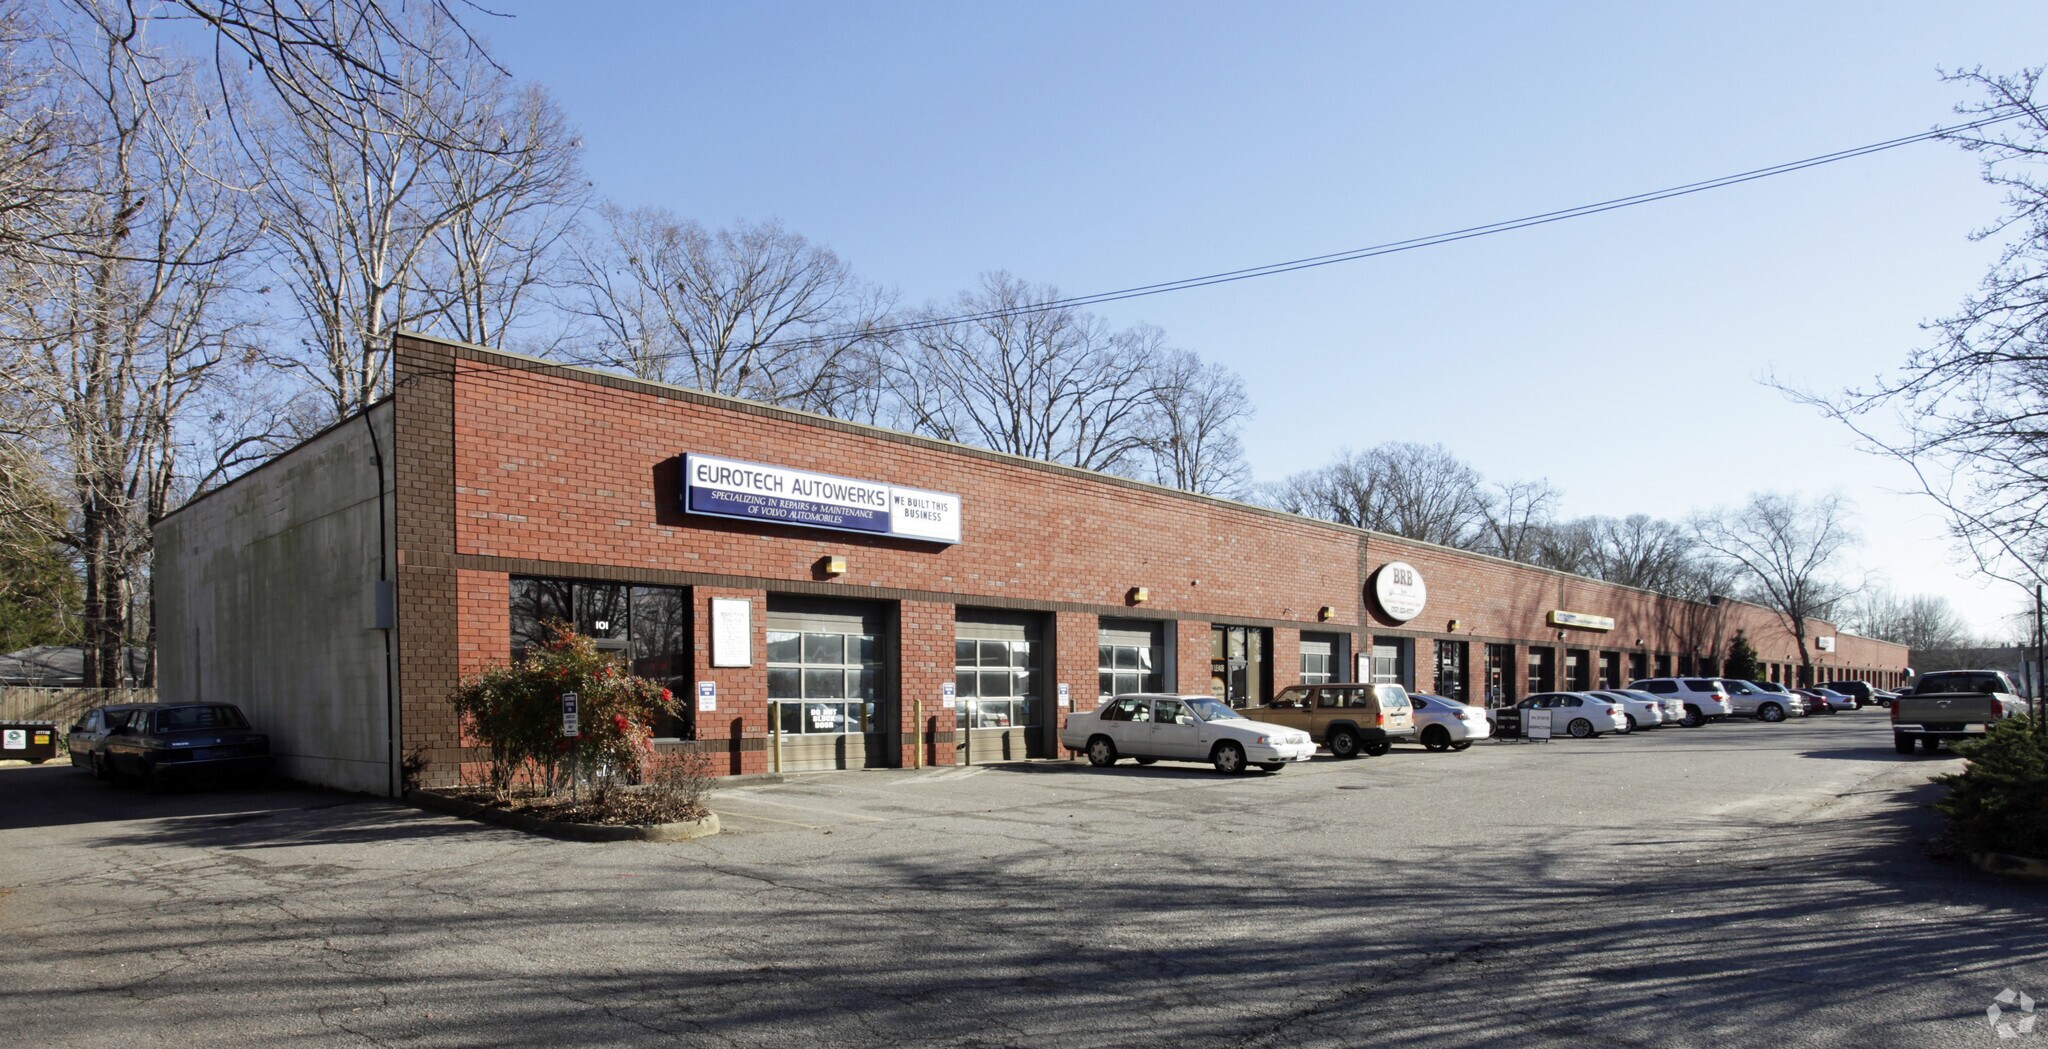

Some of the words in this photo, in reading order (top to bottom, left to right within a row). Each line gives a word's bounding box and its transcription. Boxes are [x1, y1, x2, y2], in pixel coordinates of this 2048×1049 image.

[697, 464, 783, 492] EUROTECH
[792, 478, 885, 506] AUTOWERKS
[711, 490, 766, 505] SPECIALIZING
[768, 498, 778, 506] IN
[780, 499, 809, 511] REPAIRS
[820, 505, 873, 518] MAINTENANCE
[894, 496, 904, 505] WE
[907, 497, 929, 508] BUILT
[932, 501, 948, 511] THIS
[748, 505, 759, 514] OF
[761, 507, 786, 517] VOLVO
[789, 510, 842, 523] AUTOMOBILES
[904, 508, 941, 521] BUSINESS
[1393, 567, 1413, 586] BRB
[595, 620, 609, 630] 101
